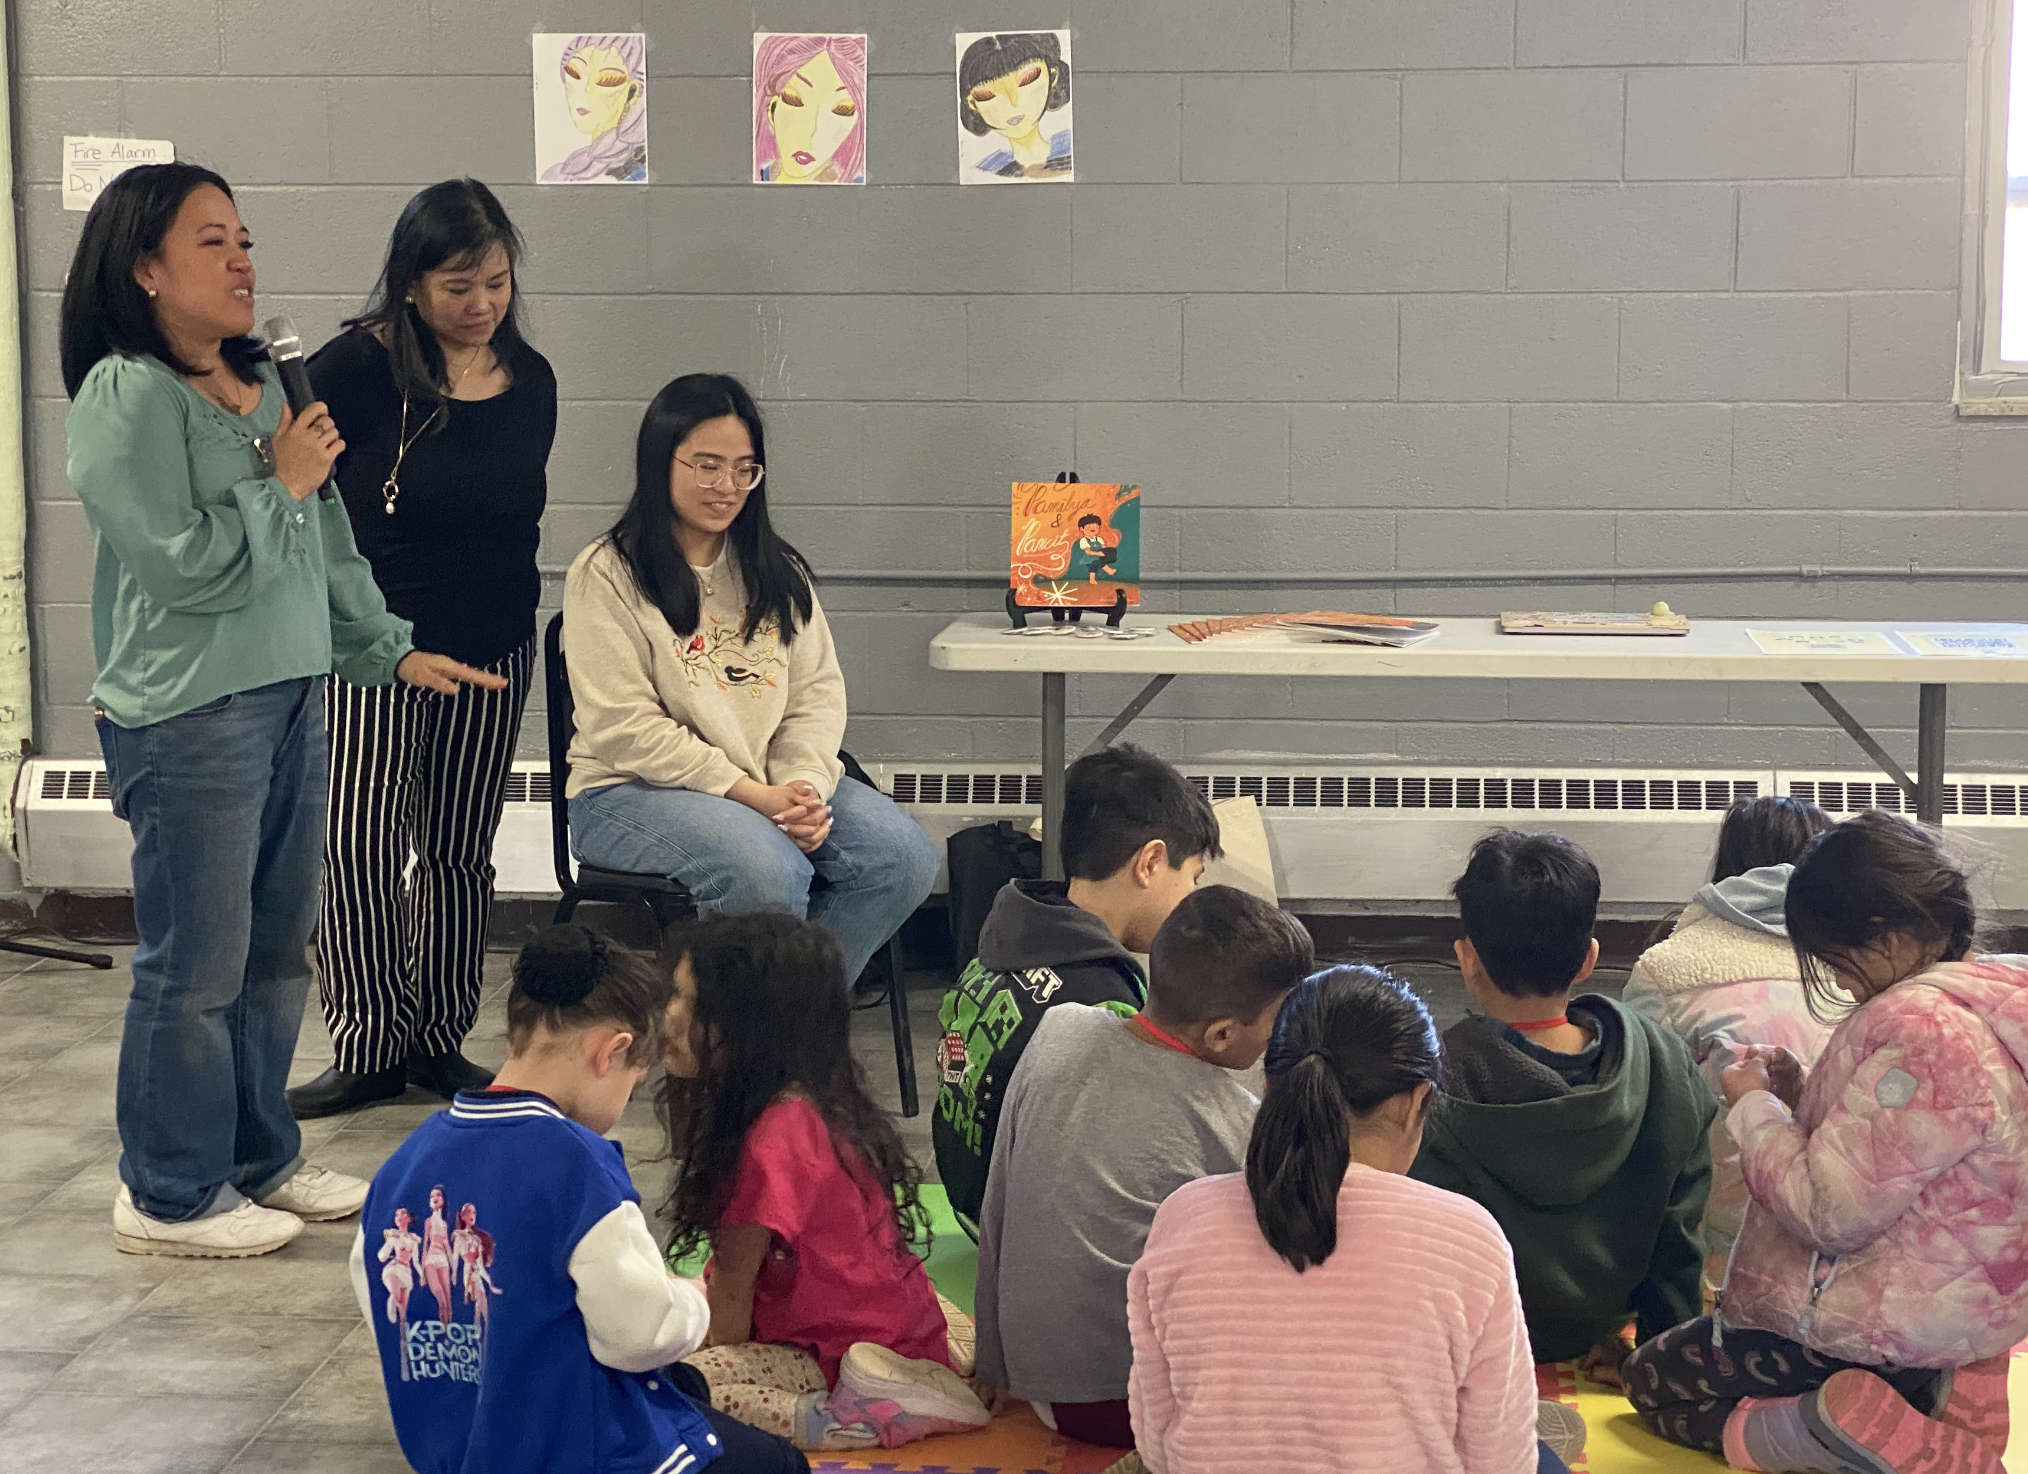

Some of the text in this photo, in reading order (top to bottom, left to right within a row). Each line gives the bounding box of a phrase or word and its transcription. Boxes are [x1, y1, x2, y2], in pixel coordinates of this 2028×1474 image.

[69, 142, 156, 160] Fire Alarm
[69, 173, 93, 193] Do
[1050, 513, 1063, 529] &
[1015, 517, 1070, 556] Pancit
[406, 1341, 482, 1364] DEMON
